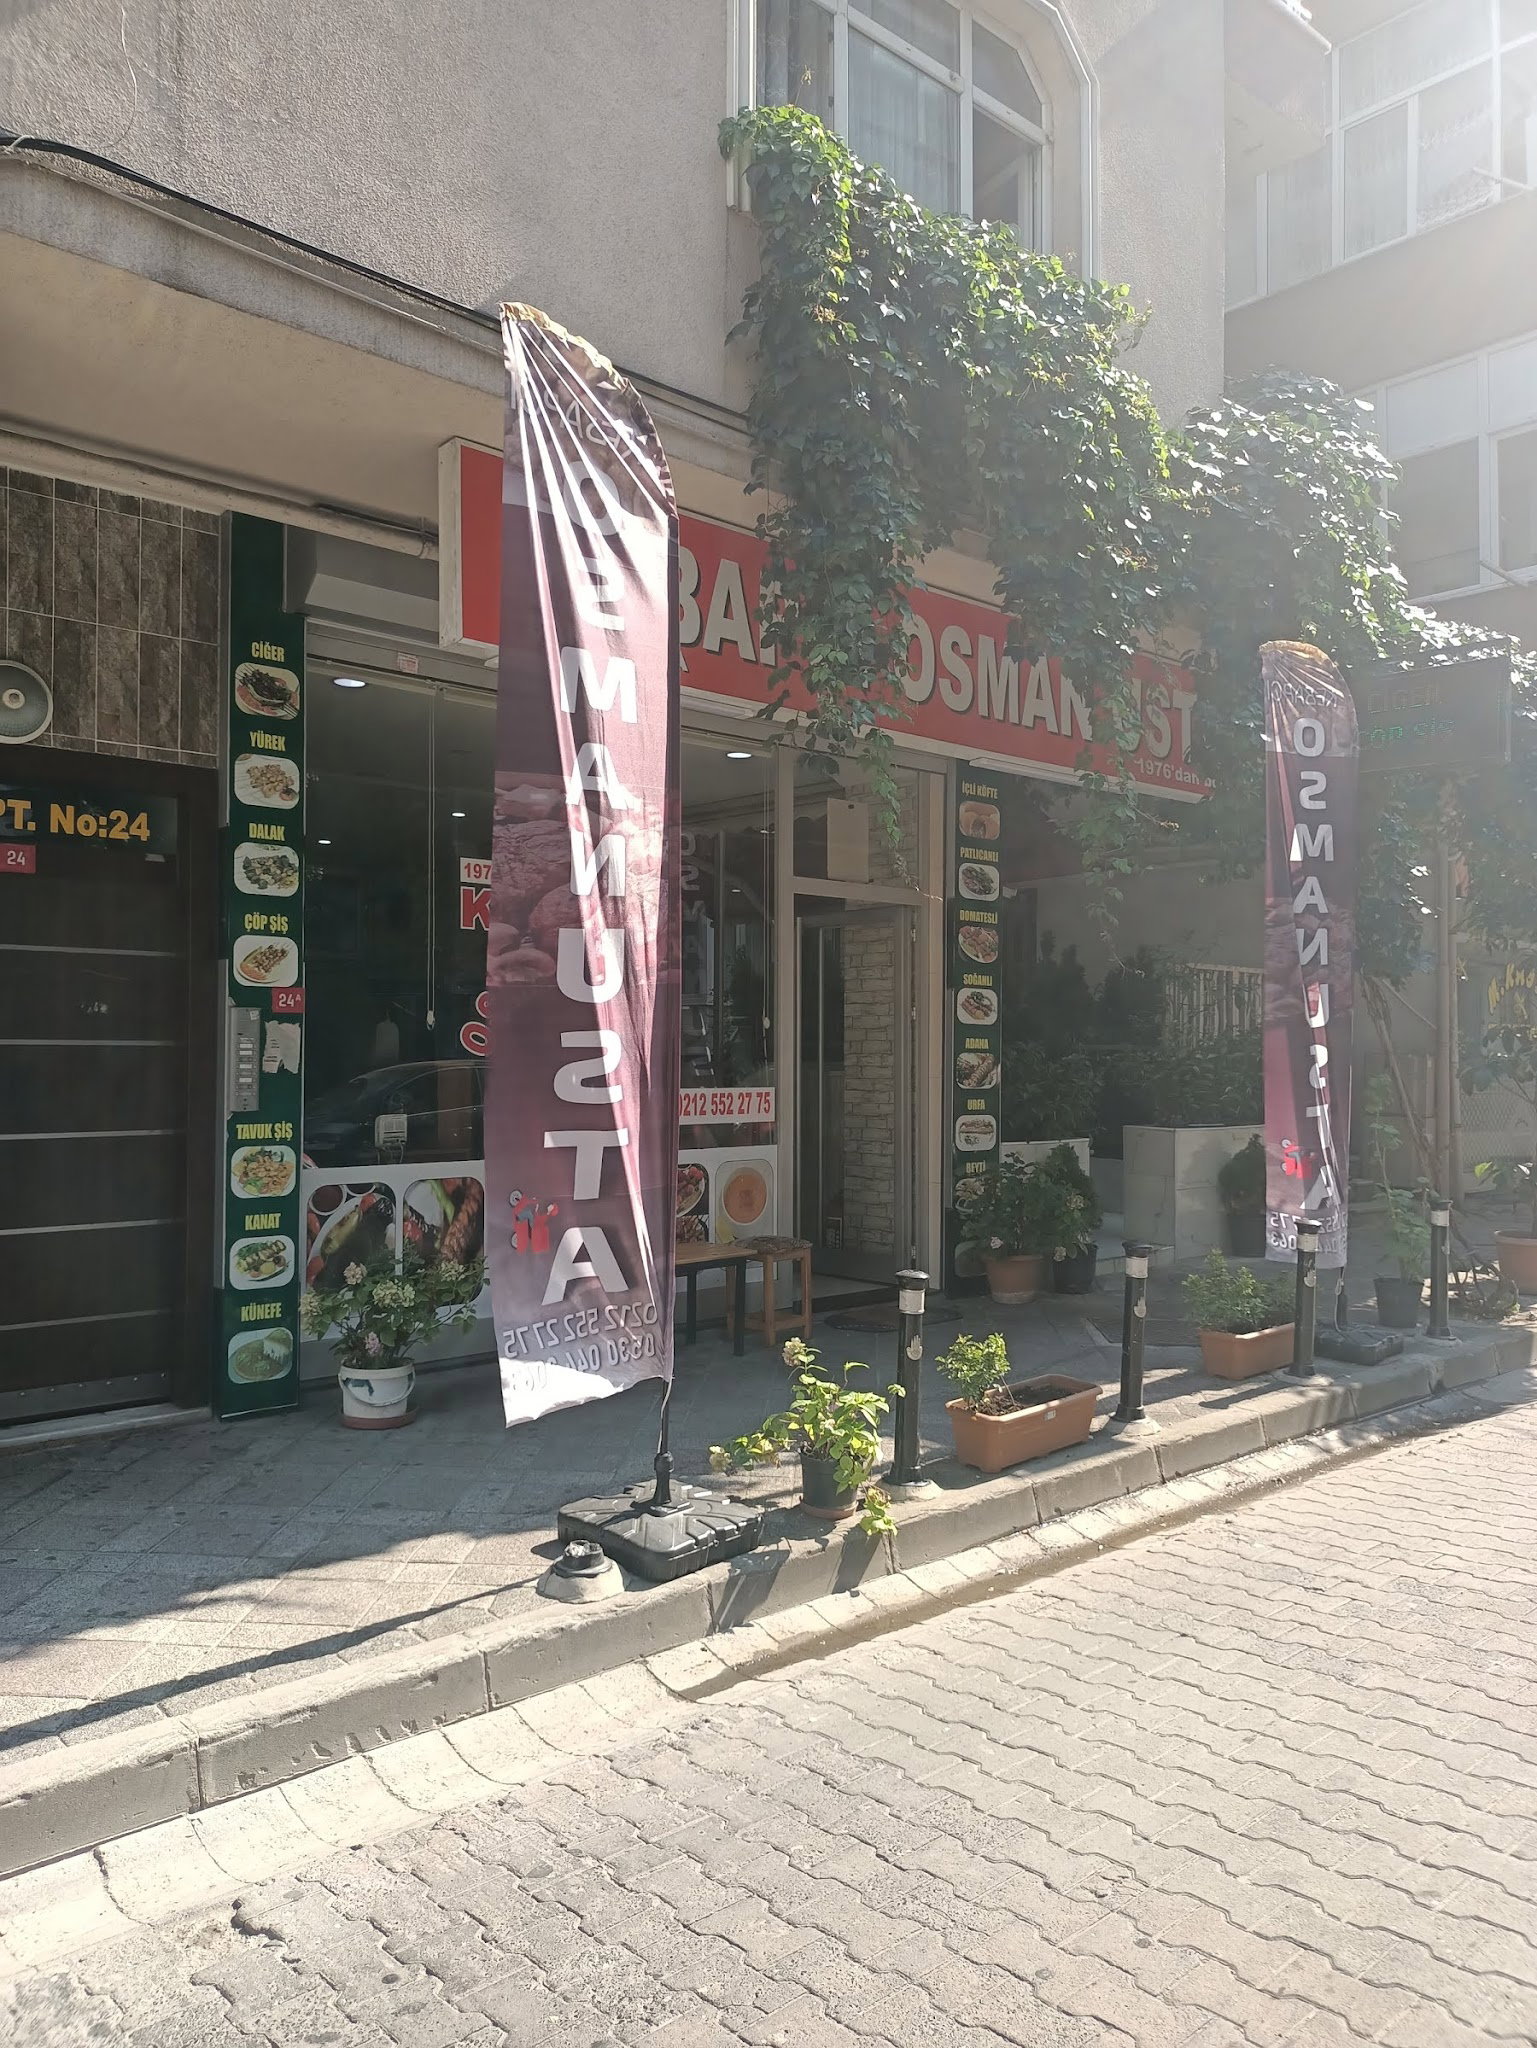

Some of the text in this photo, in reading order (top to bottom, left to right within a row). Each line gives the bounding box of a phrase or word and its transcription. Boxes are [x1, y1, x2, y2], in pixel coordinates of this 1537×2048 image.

[251, 640, 285, 663] CİĞER
[897, 613, 1093, 741] OSMAN
[249, 730, 286, 751] YÜREK
[978, 781, 998, 800] KÖFTE
[50, 803, 151, 842] No:24
[249, 823, 286, 842] DALAK
[7, 851, 26, 866] 24
[244, 914, 289, 934] ÇÖP ŞİŞ
[963, 972, 993, 987] SOĞANLI
[965, 1037, 989, 1050] ADANA
[711, 1092, 734, 1115] 552
[738, 1092, 752, 1115] 27
[756, 1091, 771, 1114] 75
[967, 1099, 986, 1111] URFA
[236, 1121, 293, 1142] TAVUK ŞİŞ
[245, 1213, 281, 1231] KANAT
[240, 1302, 282, 1322] KÜNEFE
